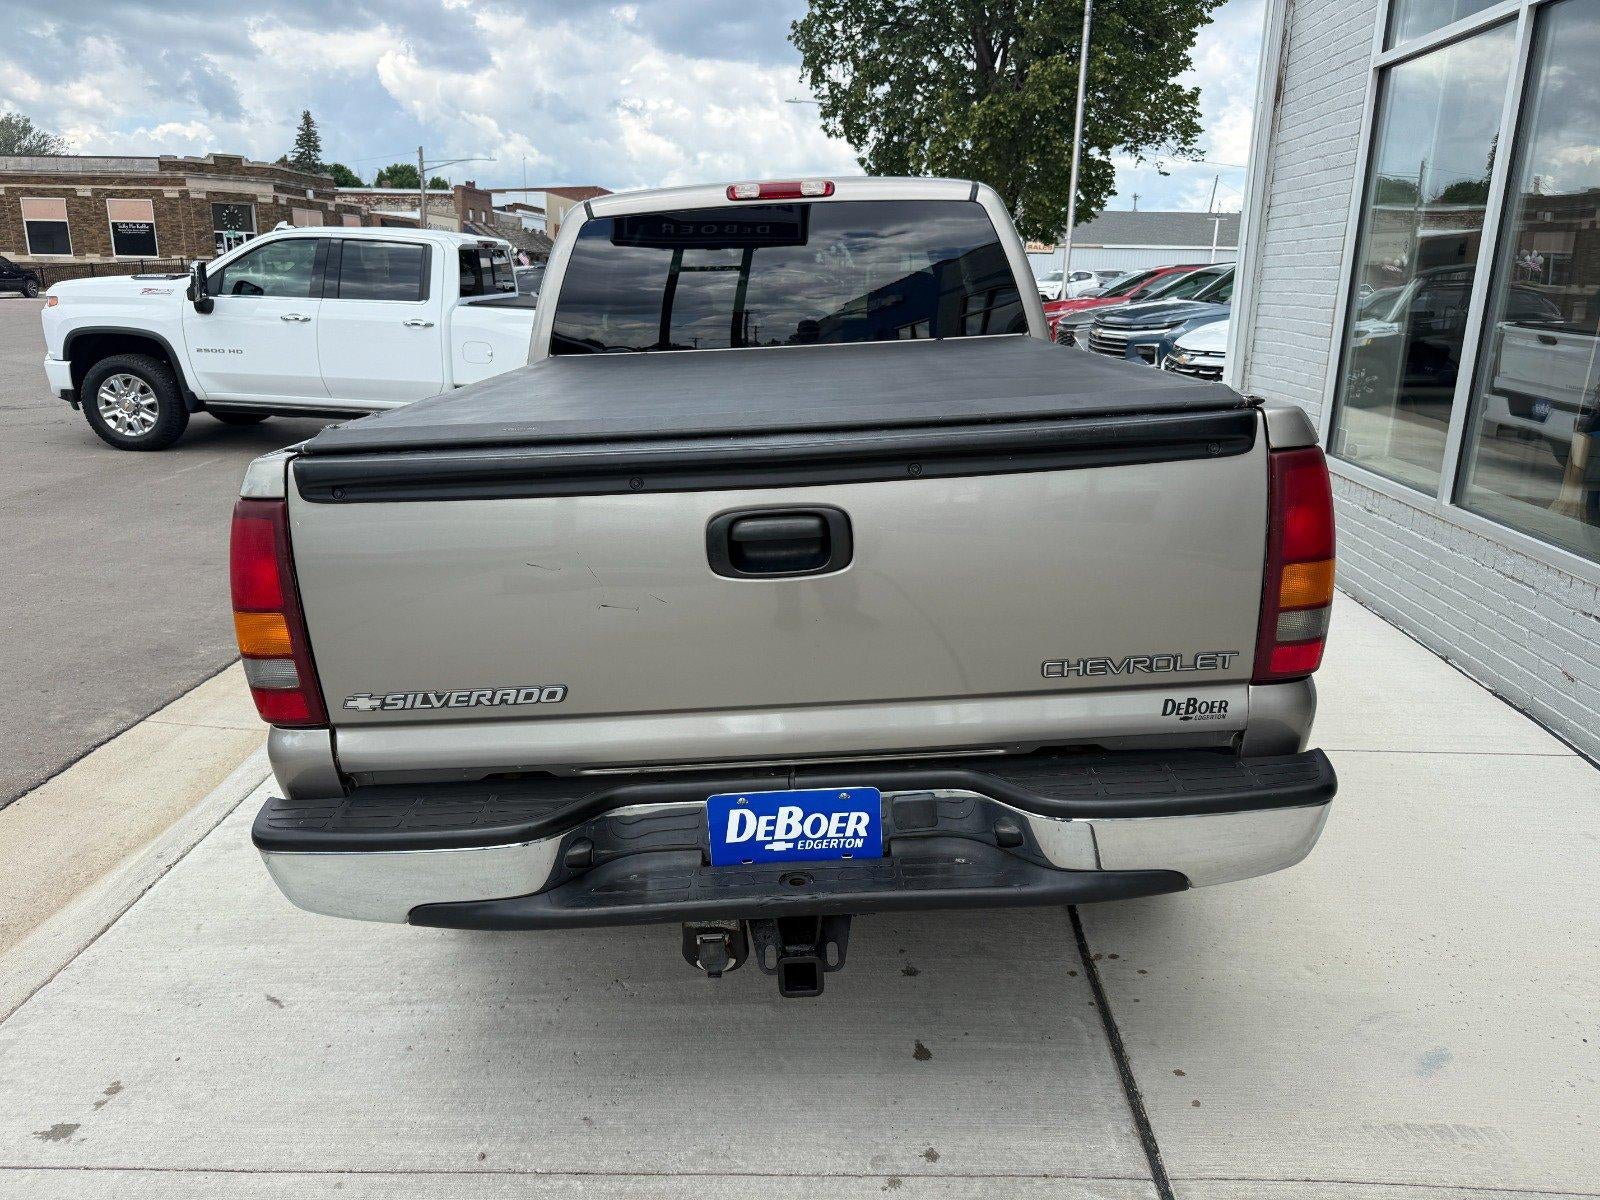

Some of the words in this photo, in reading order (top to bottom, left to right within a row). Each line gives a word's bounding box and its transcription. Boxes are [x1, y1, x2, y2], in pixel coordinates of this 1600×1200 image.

[1041, 651, 1239, 678] CHEVROLET
[382, 685, 568, 710] SILVERADO
[1161, 697, 1229, 717] DEBOER
[1194, 713, 1227, 721] EDGERTON
[725, 805, 870, 844] DEBOER
[797, 838, 864, 850] EDGERTON
